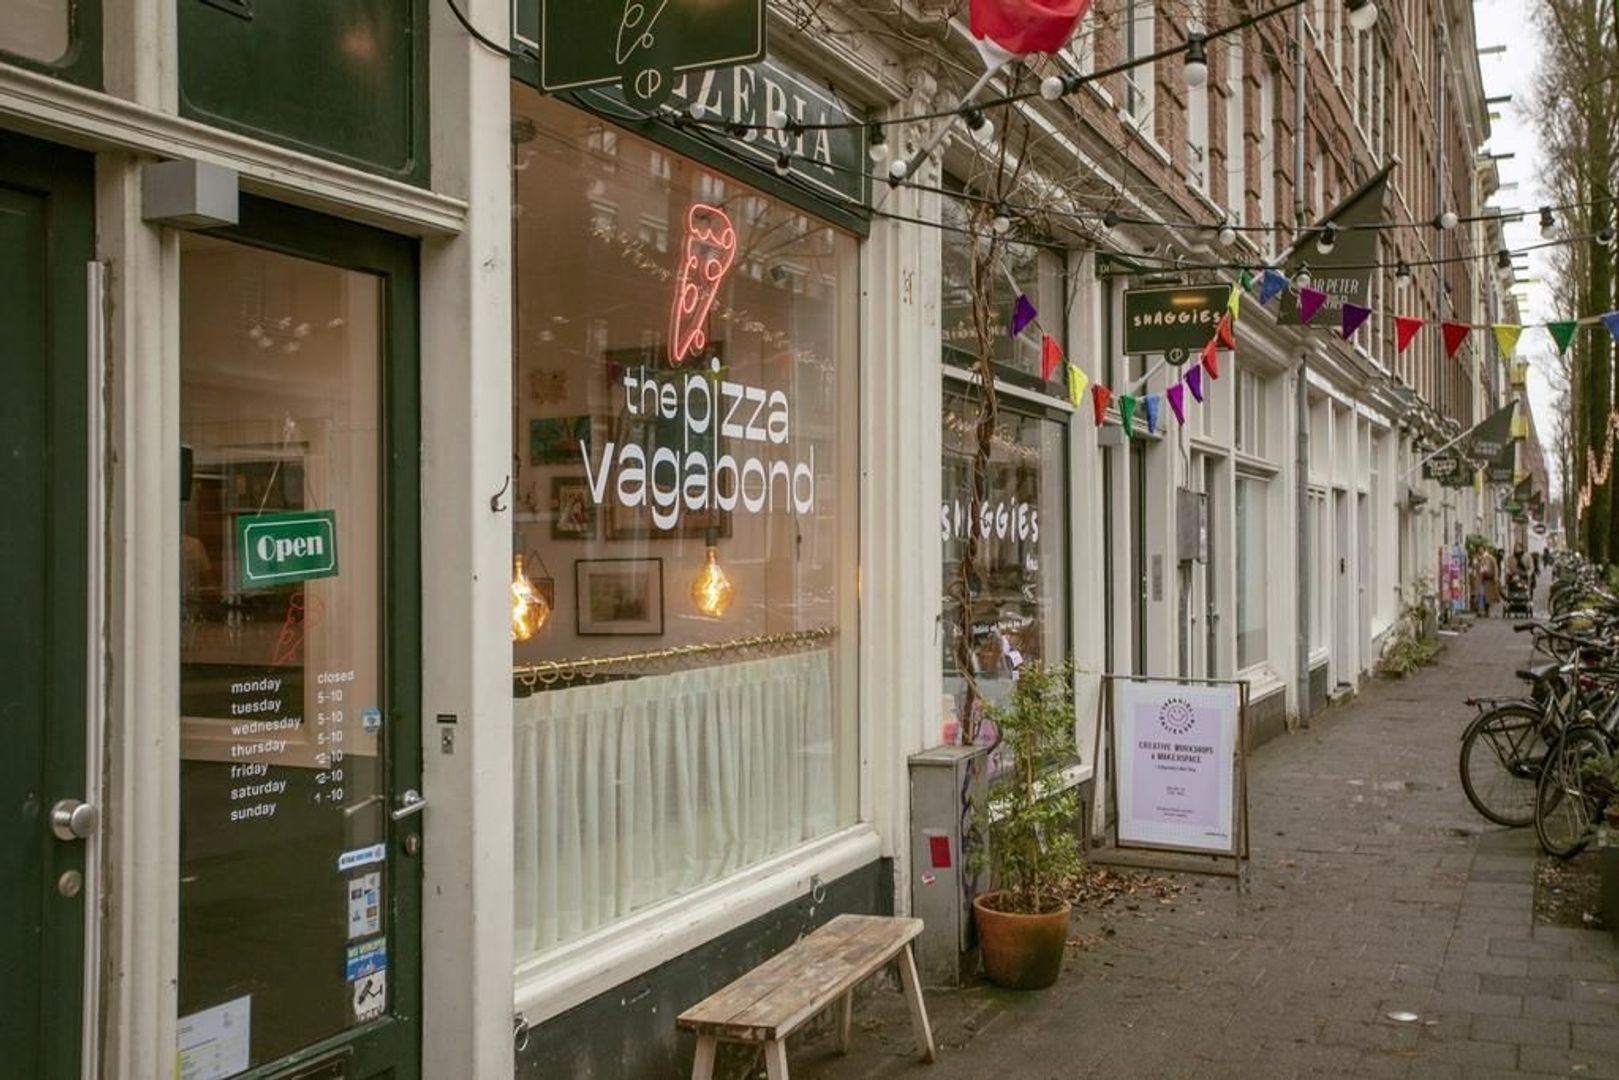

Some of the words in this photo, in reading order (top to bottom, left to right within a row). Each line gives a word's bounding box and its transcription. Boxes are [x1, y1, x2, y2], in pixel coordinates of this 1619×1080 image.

[624, 365, 678, 419] the
[684, 357, 789, 453] pizza
[580, 439, 814, 530] vagabond
[257, 534, 323, 562] Open
[231, 678, 281, 694] monday
[317, 670, 355, 684] closed
[231, 699, 281, 715] tuesday
[317, 689, 343, 704] 5-10
[231, 717, 301, 736] wednesday
[317, 711, 343, 726] 5-10
[231, 739, 286, 757] thursday
[317, 731, 343, 745] 5-10
[1138, 741, 1172, 751] CREATIVE
[1174, 743, 1214, 755] WORKSHOPS
[1157, 753, 1202, 763] MAKERSPACE
[231, 763, 269, 778] friday
[231, 780, 287, 800] saturday
[231, 802, 276, 821] sunday
